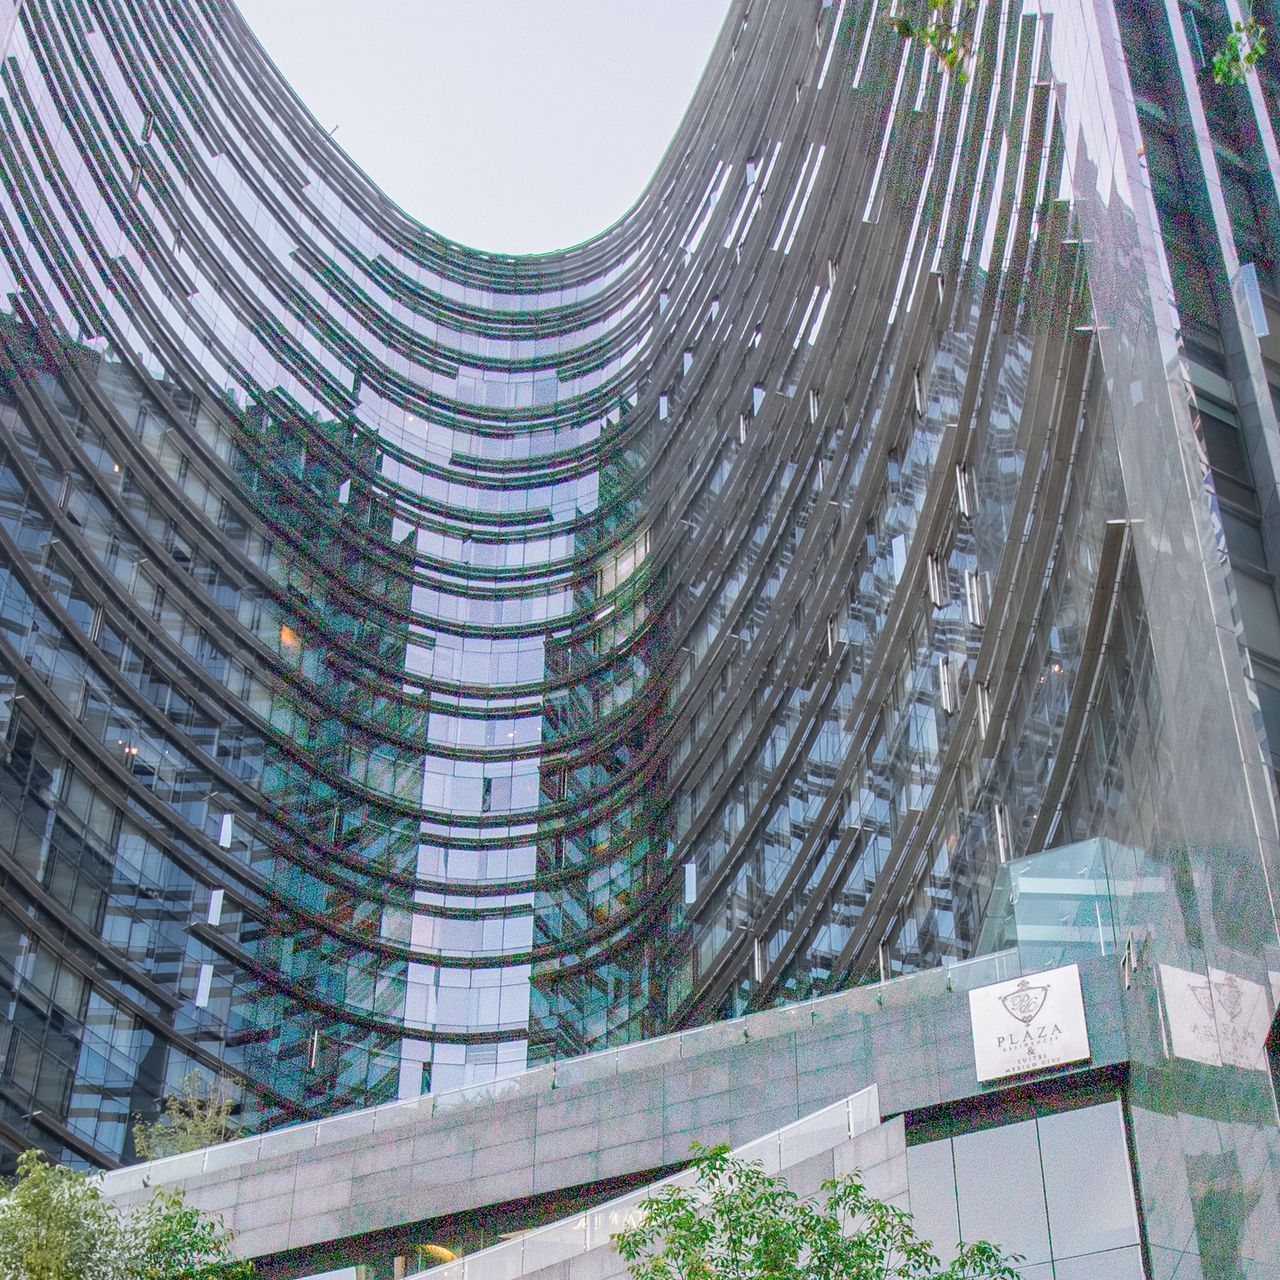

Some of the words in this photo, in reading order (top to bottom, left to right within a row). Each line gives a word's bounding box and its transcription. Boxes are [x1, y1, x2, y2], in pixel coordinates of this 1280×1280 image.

[997, 1024, 1062, 1047] PLAZA
[1027, 1047, 1035, 1056] &
[1017, 1054, 1047, 1064] SUITES
[1005, 1063, 1037, 1073] MEXICO
